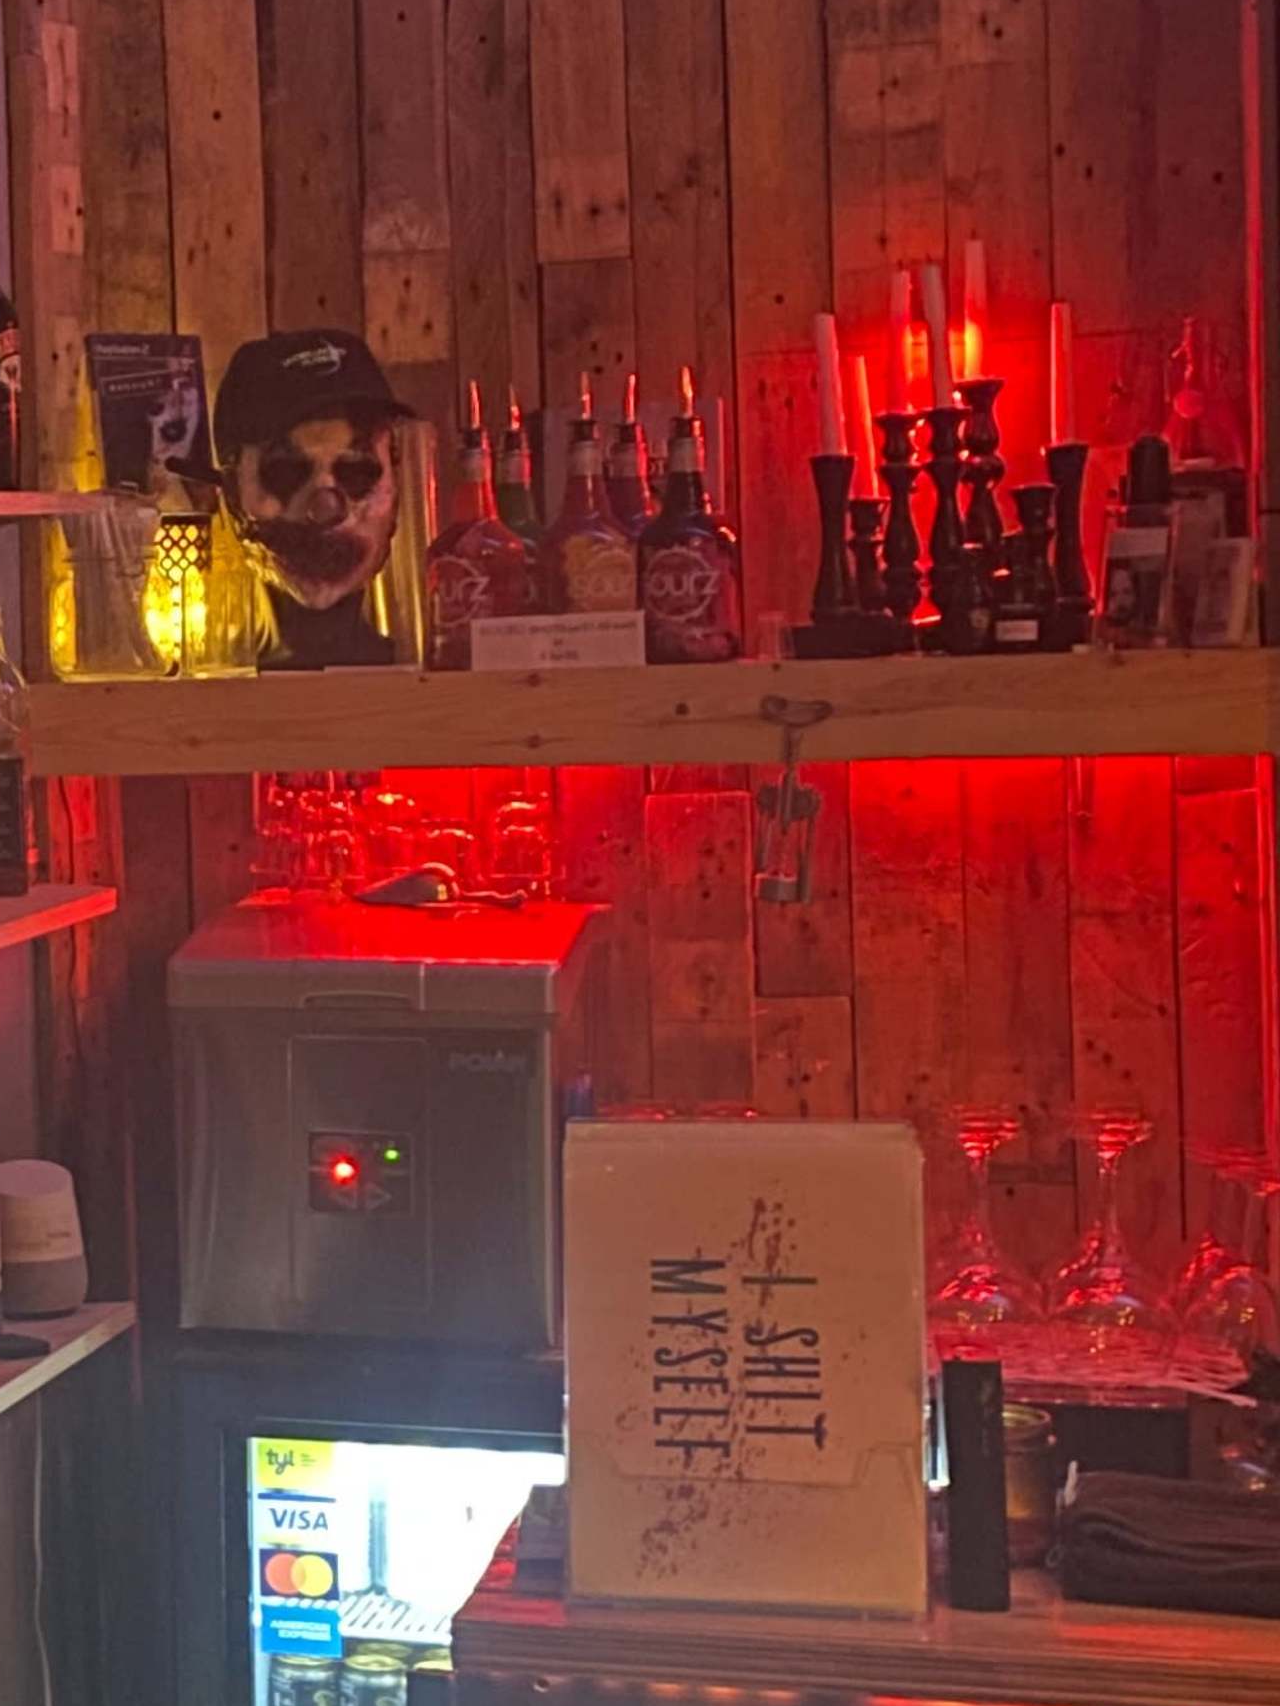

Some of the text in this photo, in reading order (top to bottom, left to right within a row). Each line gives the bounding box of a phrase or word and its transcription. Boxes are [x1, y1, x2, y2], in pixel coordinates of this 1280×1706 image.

[649, 1258, 732, 1461] MYSELF
[742, 1327, 827, 1451] SHIT
[265, 1448, 296, 1476] tyl
[269, 1507, 329, 1531] VISA
